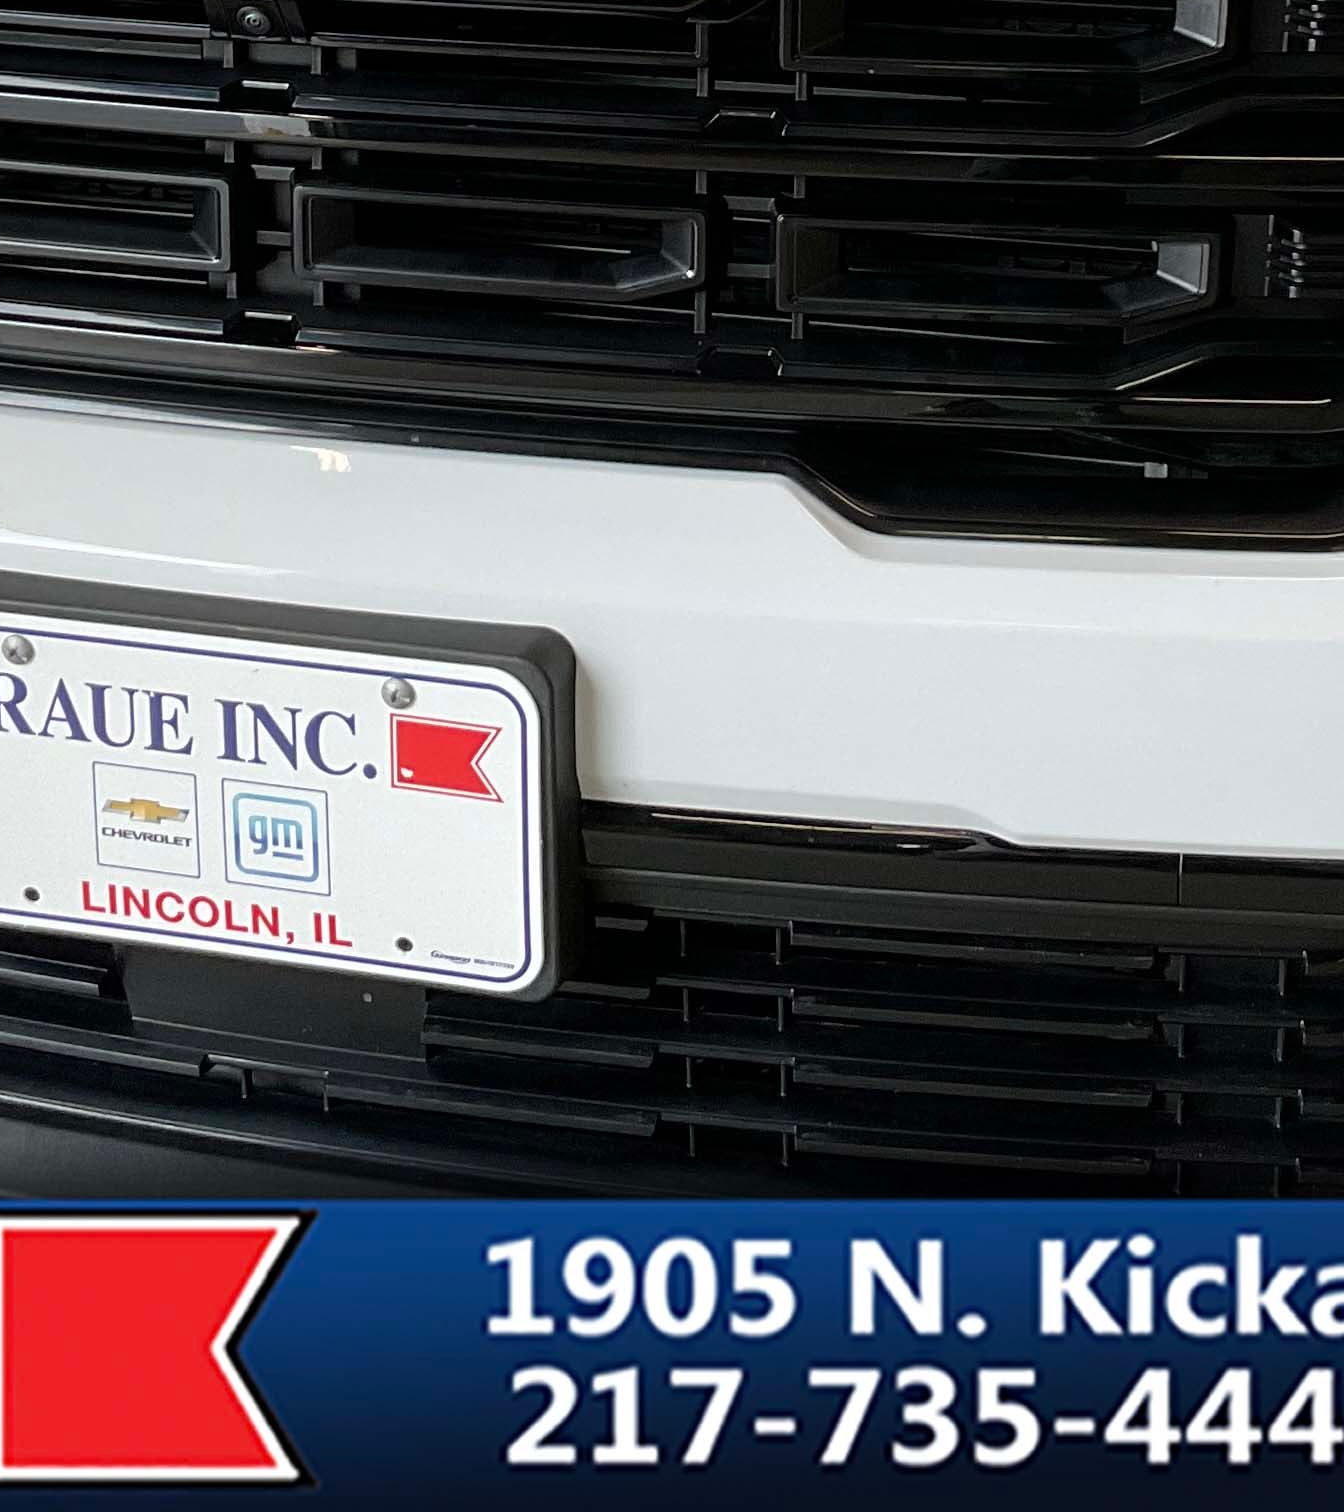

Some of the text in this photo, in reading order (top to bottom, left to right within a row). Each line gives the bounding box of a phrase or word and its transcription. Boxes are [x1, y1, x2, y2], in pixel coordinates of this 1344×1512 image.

[215, 698, 379, 779] INC.
[101, 826, 193, 848] CHEVROLET
[248, 815, 304, 860] gm
[81, 880, 353, 947] LINCOLN, IL
